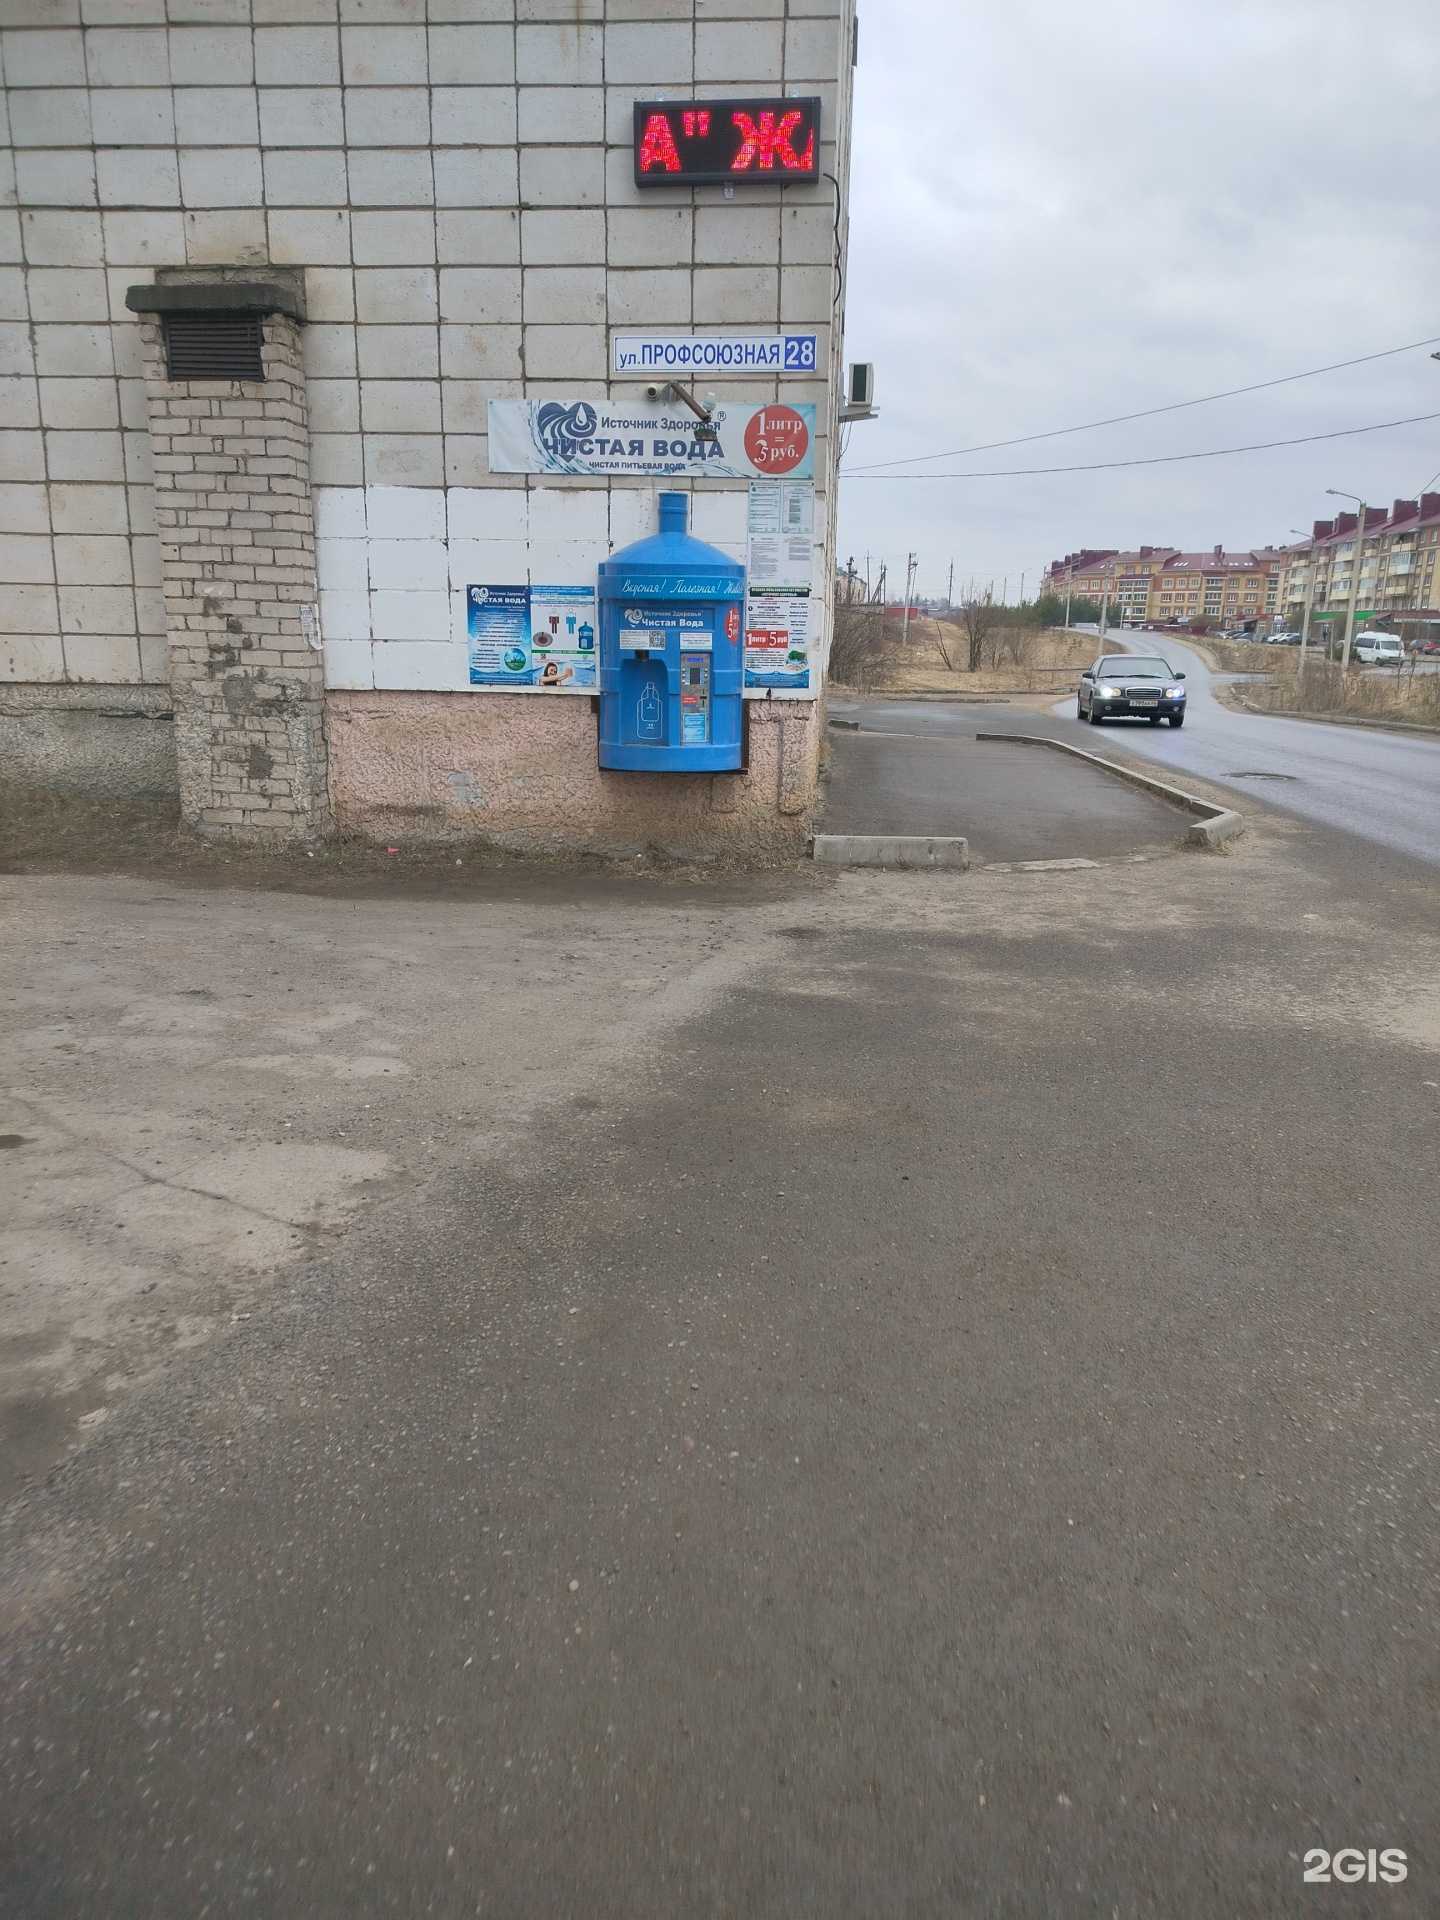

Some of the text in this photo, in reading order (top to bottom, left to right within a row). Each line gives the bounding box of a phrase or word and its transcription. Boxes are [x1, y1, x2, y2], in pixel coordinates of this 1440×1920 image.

[641, 343, 780, 365] ПРОФСОЮЗНАЯ
[786, 340, 815, 366] 28
[601, 416, 658, 431] Источник
[543, 438, 725, 460] ЧИСТАЯ ВОДА
[588, 461, 620, 469] ЧИСТАЯ
[642, 618, 704, 629] Чистая Вода
